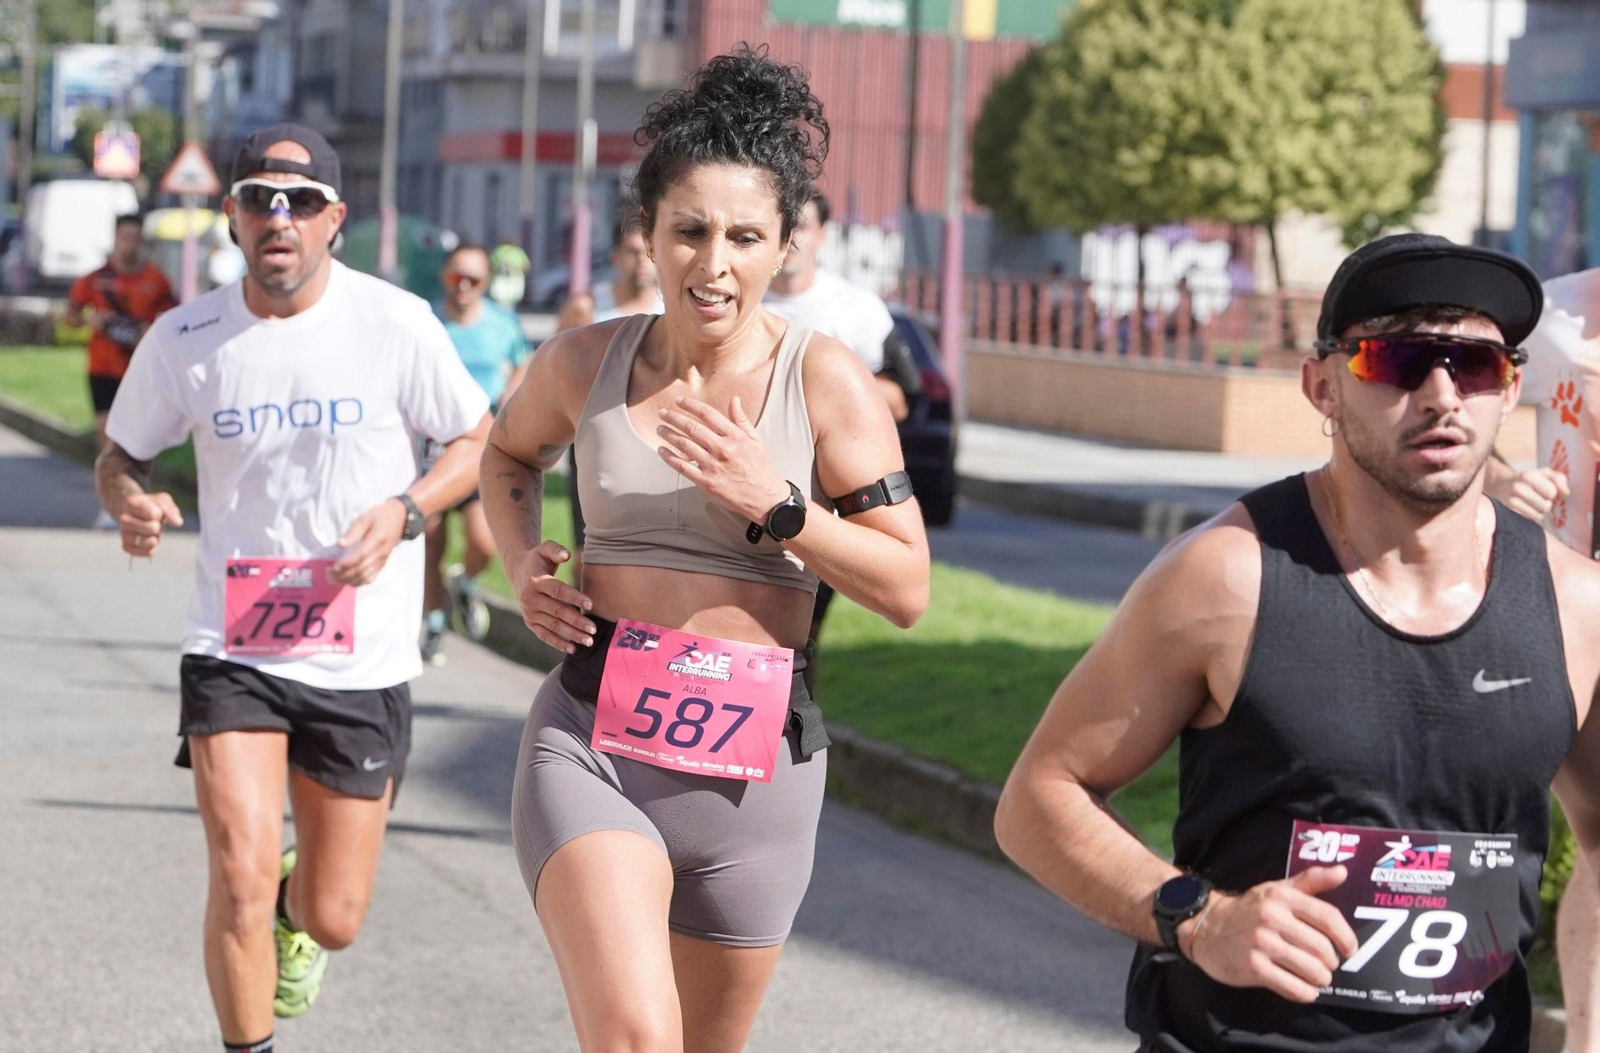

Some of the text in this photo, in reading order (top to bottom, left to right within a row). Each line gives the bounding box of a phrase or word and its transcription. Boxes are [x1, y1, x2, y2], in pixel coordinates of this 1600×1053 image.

[213, 397, 363, 438] snop
[250, 602, 329, 639] 726
[617, 626, 648, 651] 20
[668, 662, 731, 681] INTERRUNNING
[685, 650, 732, 673] CAE
[682, 684, 707, 696] ALBA
[625, 687, 755, 754] 587
[1298, 828, 1342, 863] 20
[1395, 849, 1452, 872] CAE
[1375, 869, 1452, 886] INTERRUNNING
[1374, 892, 1448, 910] TELMO CHAO
[1340, 905, 1468, 979] 78
